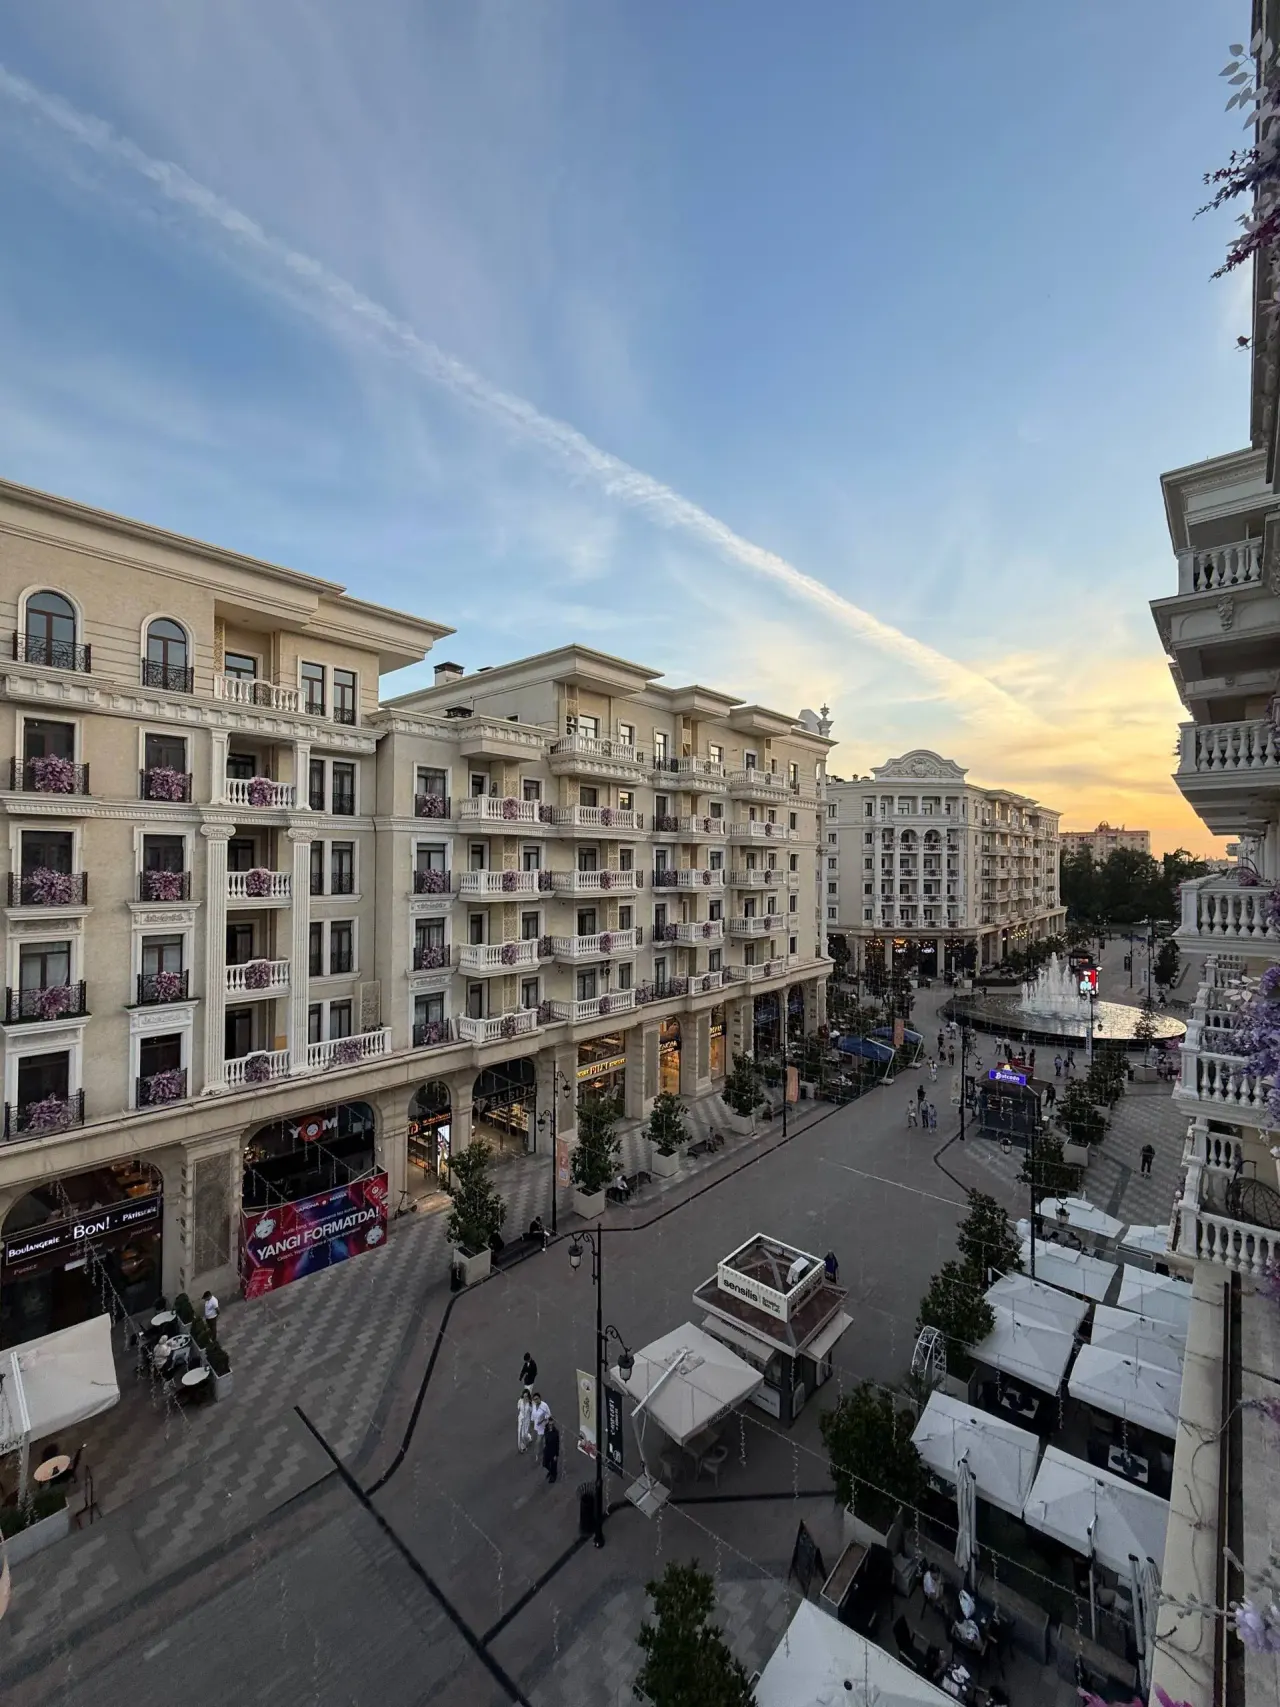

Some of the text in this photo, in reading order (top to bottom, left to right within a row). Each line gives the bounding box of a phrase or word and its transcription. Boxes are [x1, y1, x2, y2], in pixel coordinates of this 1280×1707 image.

[257, 1236, 301, 1260] YANGI
[303, 1206, 380, 1244] FORMATDA!
[723, 1279, 758, 1302] sensilis
